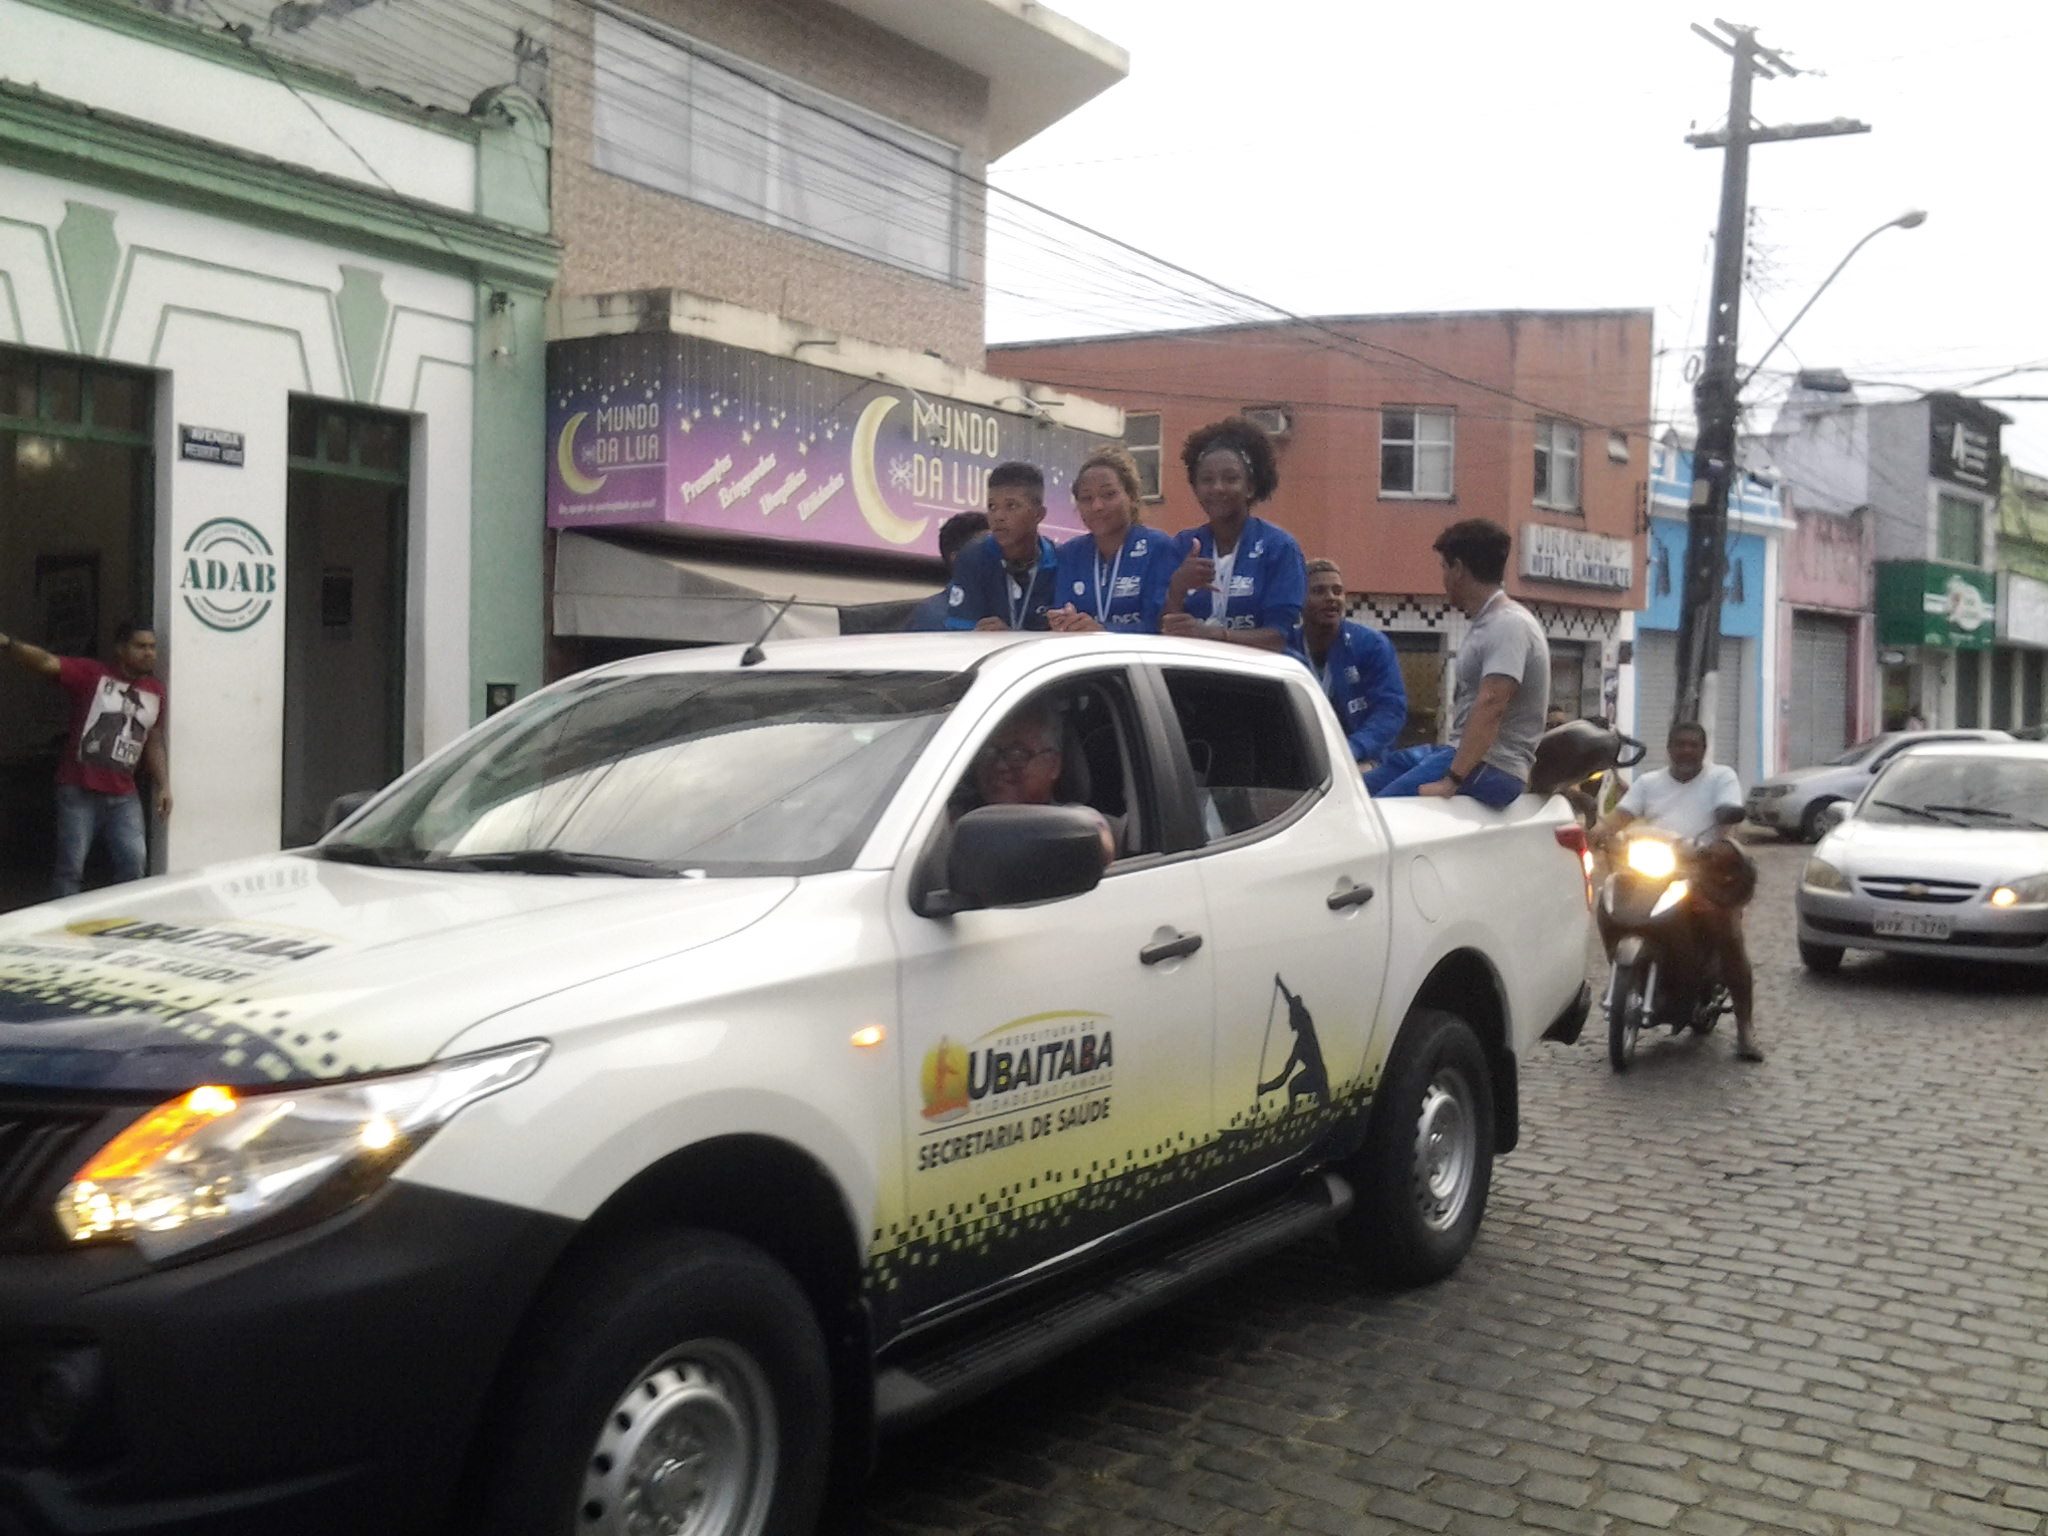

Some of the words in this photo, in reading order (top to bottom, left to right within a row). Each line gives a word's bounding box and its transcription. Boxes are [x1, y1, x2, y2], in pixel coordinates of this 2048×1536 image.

[597, 403, 659, 433] MUNDO
[912, 398, 999, 458] MUNDO
[597, 437, 618, 464] DA
[625, 433, 659, 461] LUA
[912, 453, 943, 499] DA
[180, 557, 276, 593] ADAB
[968, 1031, 1113, 1100] UBAITABA
[918, 1121, 1025, 1171] SECRETARIA
[1030, 1113, 1051, 1140] DE
